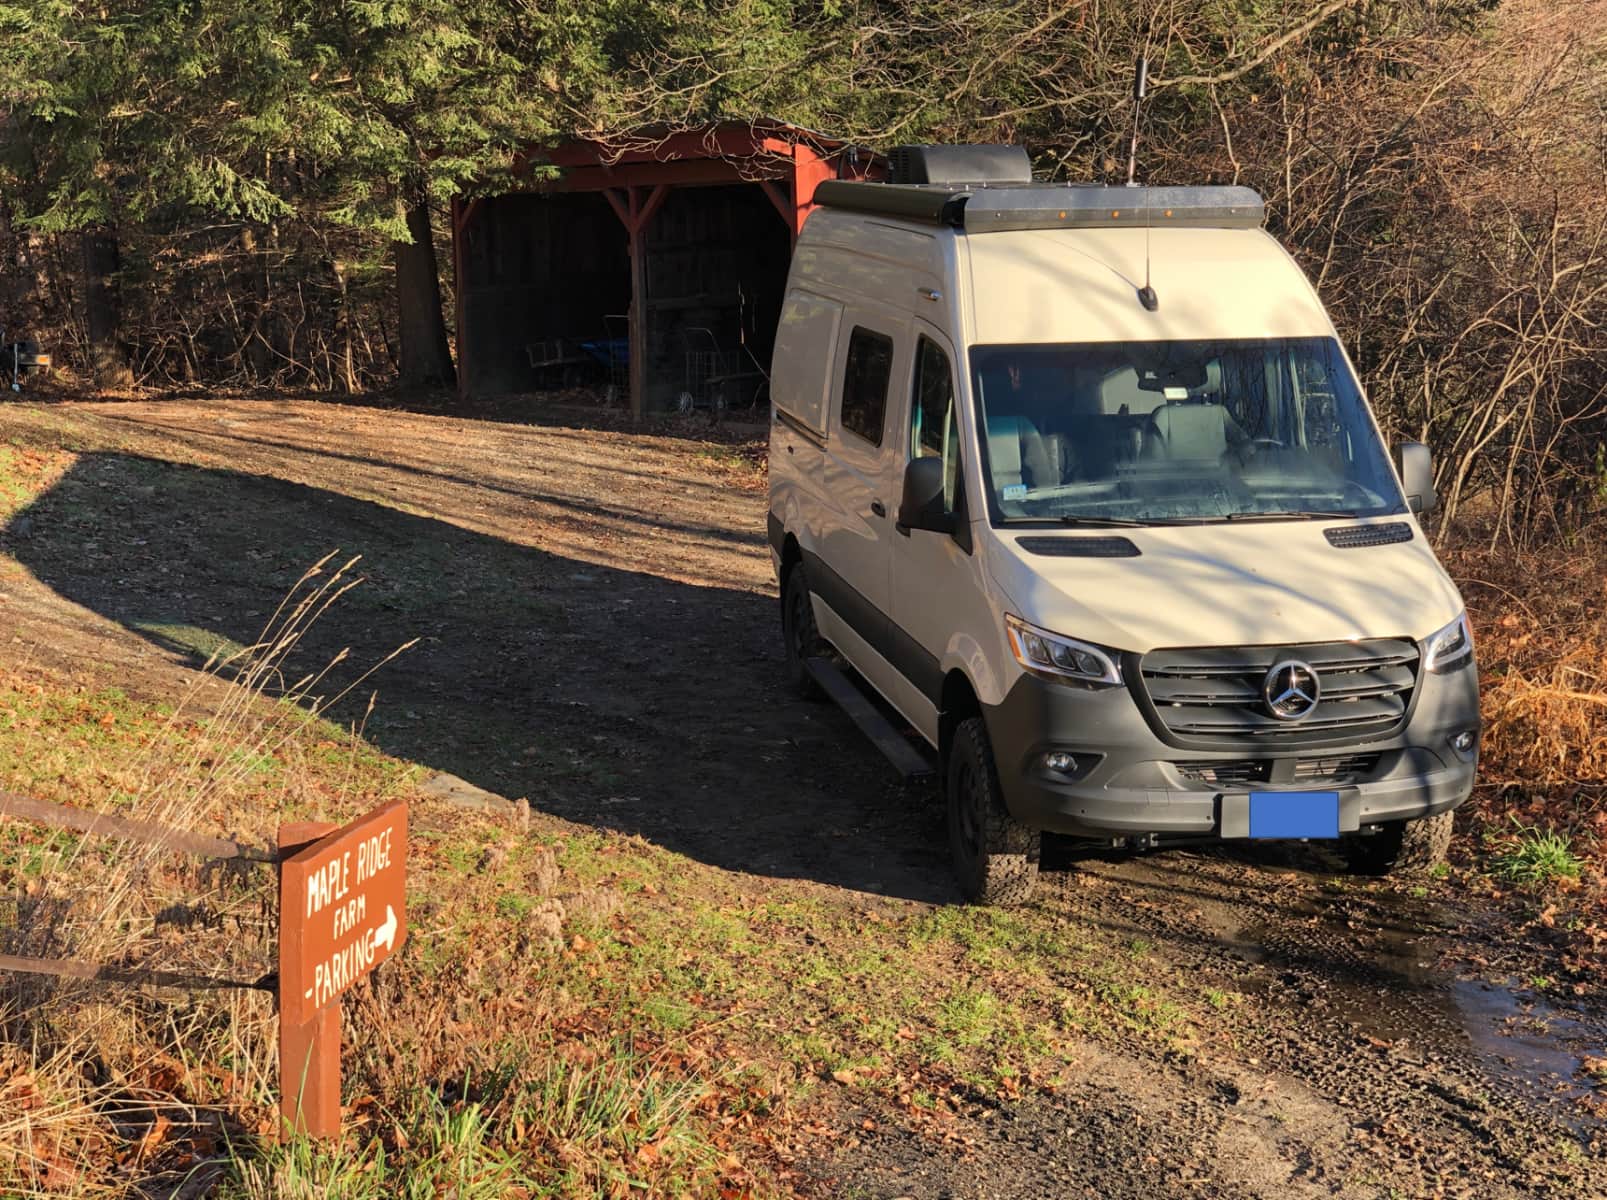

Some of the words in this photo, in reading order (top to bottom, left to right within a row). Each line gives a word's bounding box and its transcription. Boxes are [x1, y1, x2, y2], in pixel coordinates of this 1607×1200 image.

[307, 851, 350, 919] MAPLE
[357, 827, 392, 885] RIDGE
[334, 893, 365, 940] FARM
